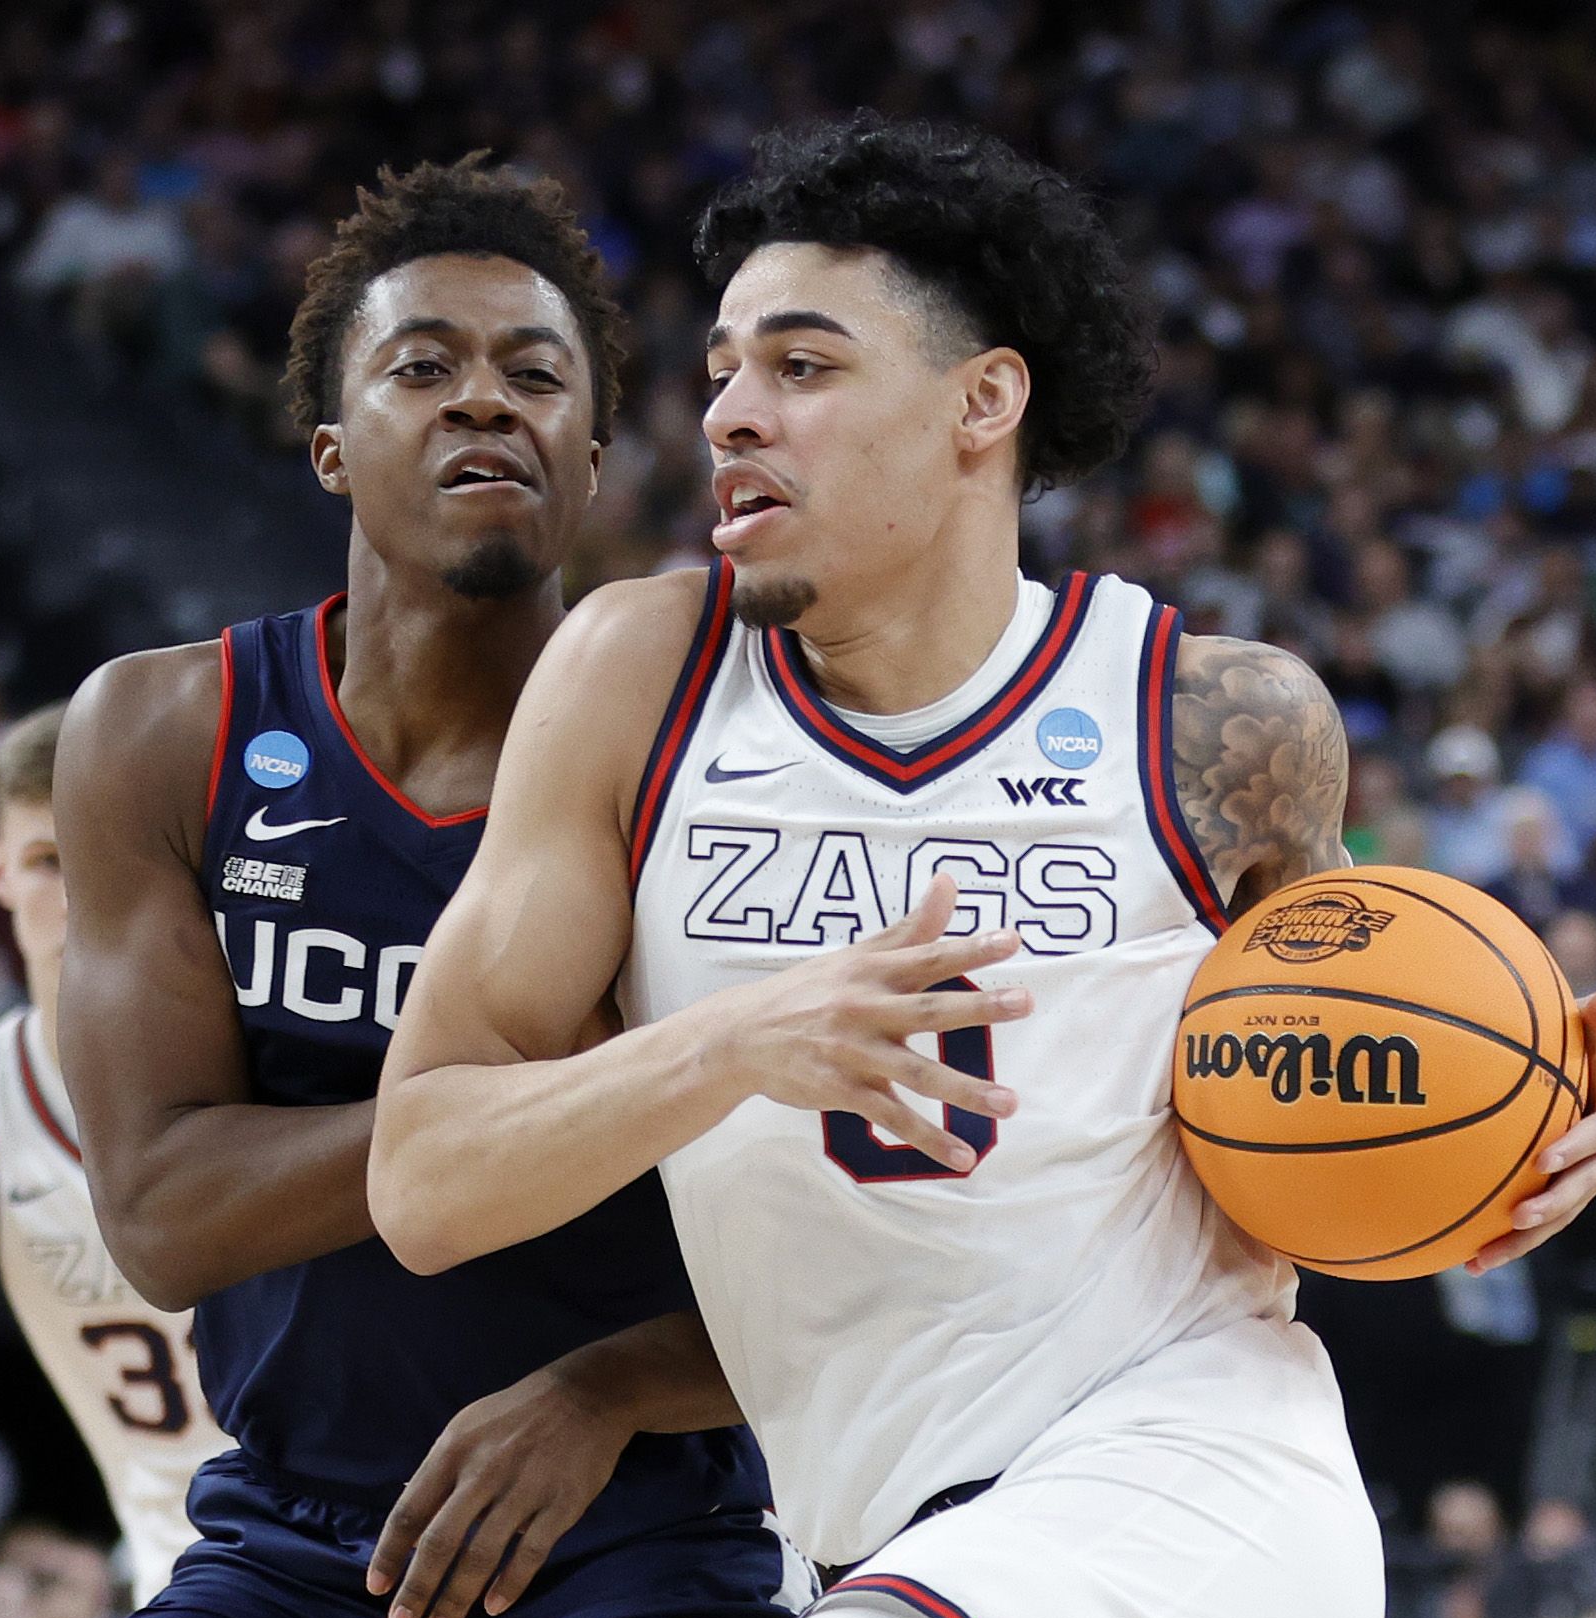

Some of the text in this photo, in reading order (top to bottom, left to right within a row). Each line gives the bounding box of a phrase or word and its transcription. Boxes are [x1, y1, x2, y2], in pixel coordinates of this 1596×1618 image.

[1046, 735, 1099, 754] NCAA
[249, 753, 303, 778] NCAA
[996, 777, 1088, 808] WCC
[221, 876, 305, 901] CHANGE
[684, 824, 1117, 957] ZAGS
[1257, 910, 1352, 930] MADNESS
[1275, 924, 1351, 945] MARCH
[1243, 1015, 1320, 1027] EVO NXT
[1186, 1030, 1427, 1106] Wilson
